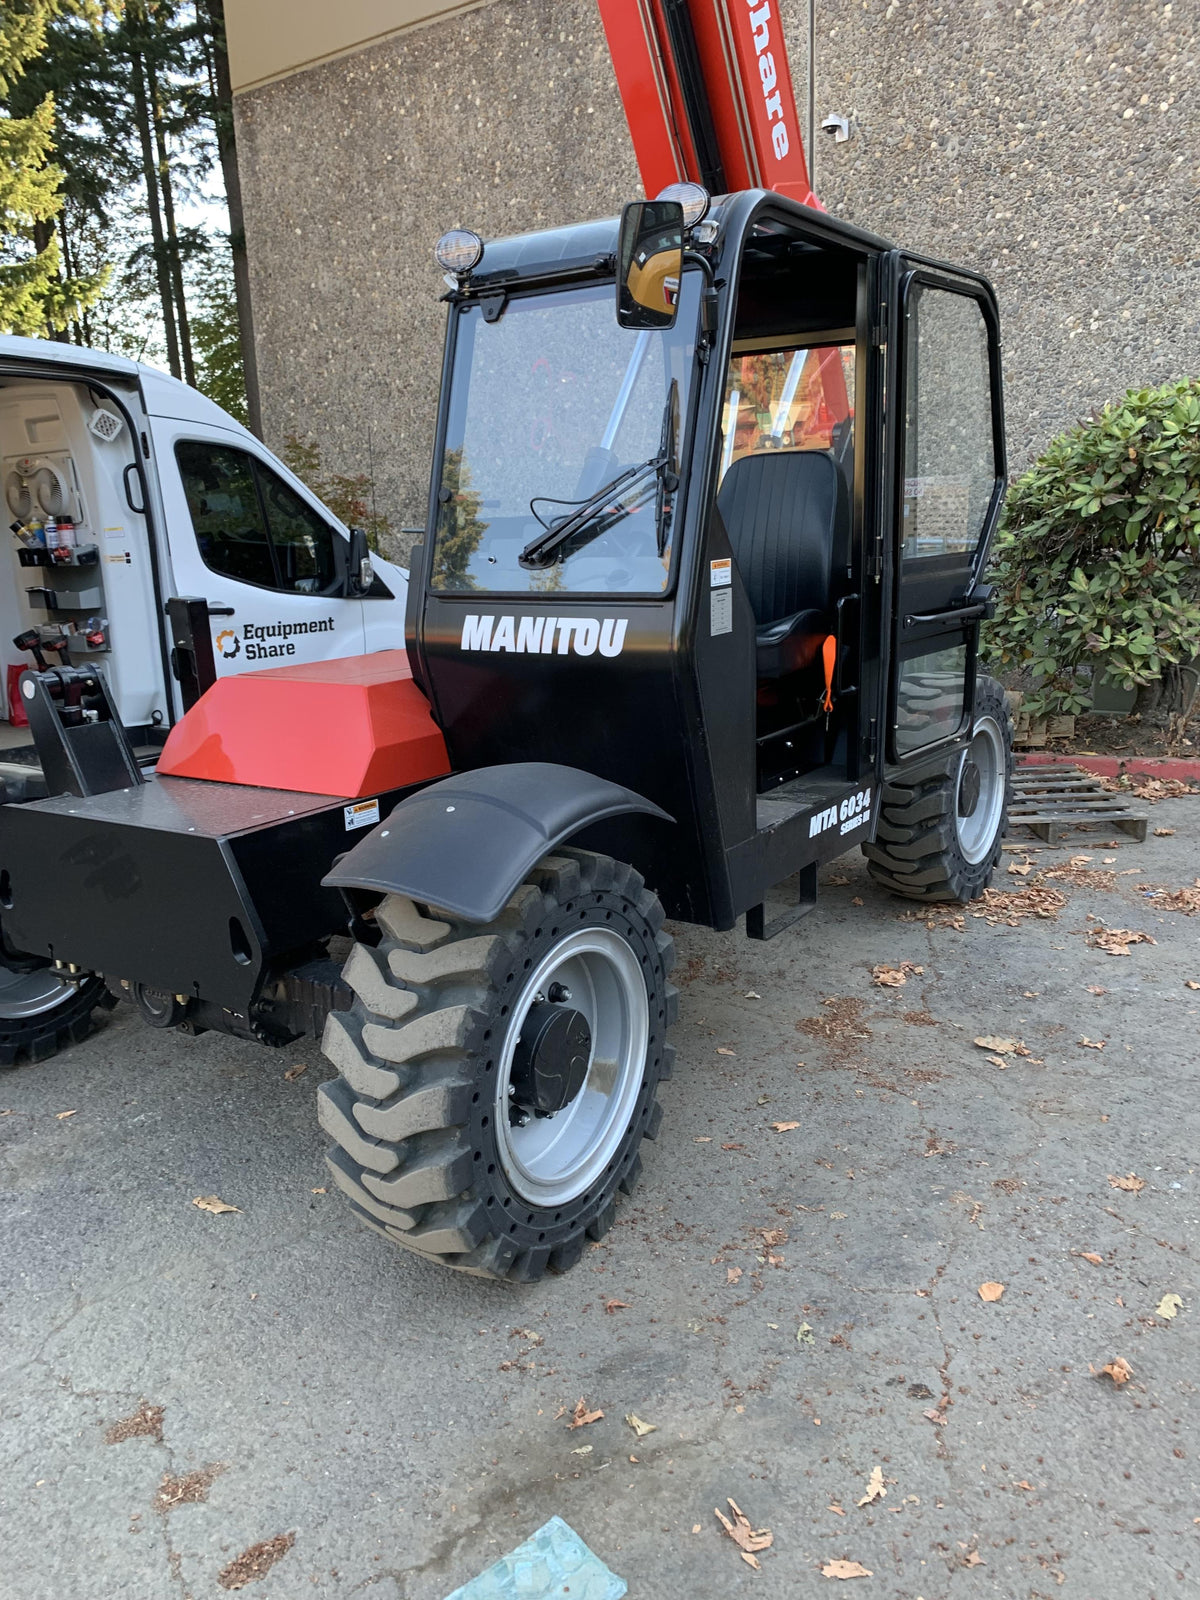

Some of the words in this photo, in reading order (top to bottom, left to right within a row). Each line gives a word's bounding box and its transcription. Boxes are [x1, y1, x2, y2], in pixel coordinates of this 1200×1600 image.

[747, 0, 789, 160] hare
[243, 617, 335, 642] Equipment
[461, 615, 629, 658] MANITOU
[245, 643, 296, 660] Share
[809, 805, 838, 838] MTA
[840, 788, 871, 821] 6034
